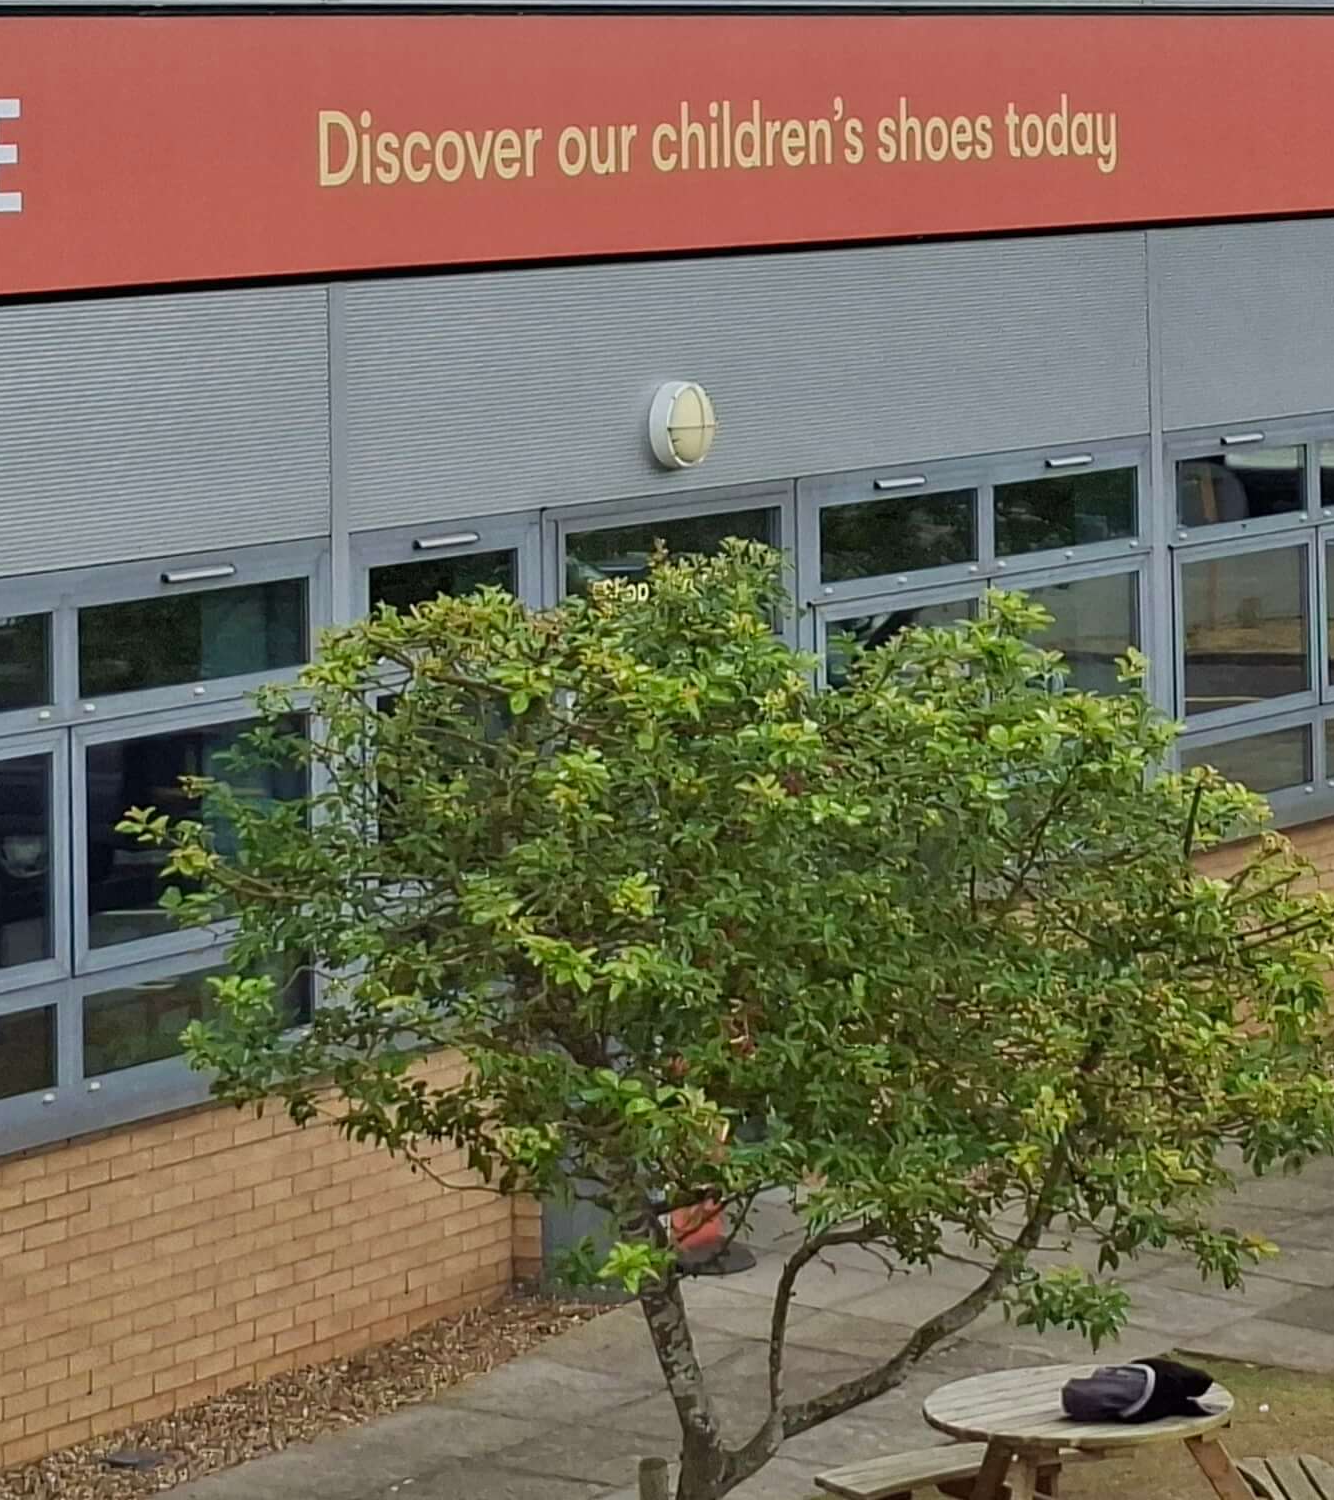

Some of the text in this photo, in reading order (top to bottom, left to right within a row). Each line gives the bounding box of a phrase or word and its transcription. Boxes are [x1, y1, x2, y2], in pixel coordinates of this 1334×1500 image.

[318, 93, 1117, 187] Discover our children’s shoes today
